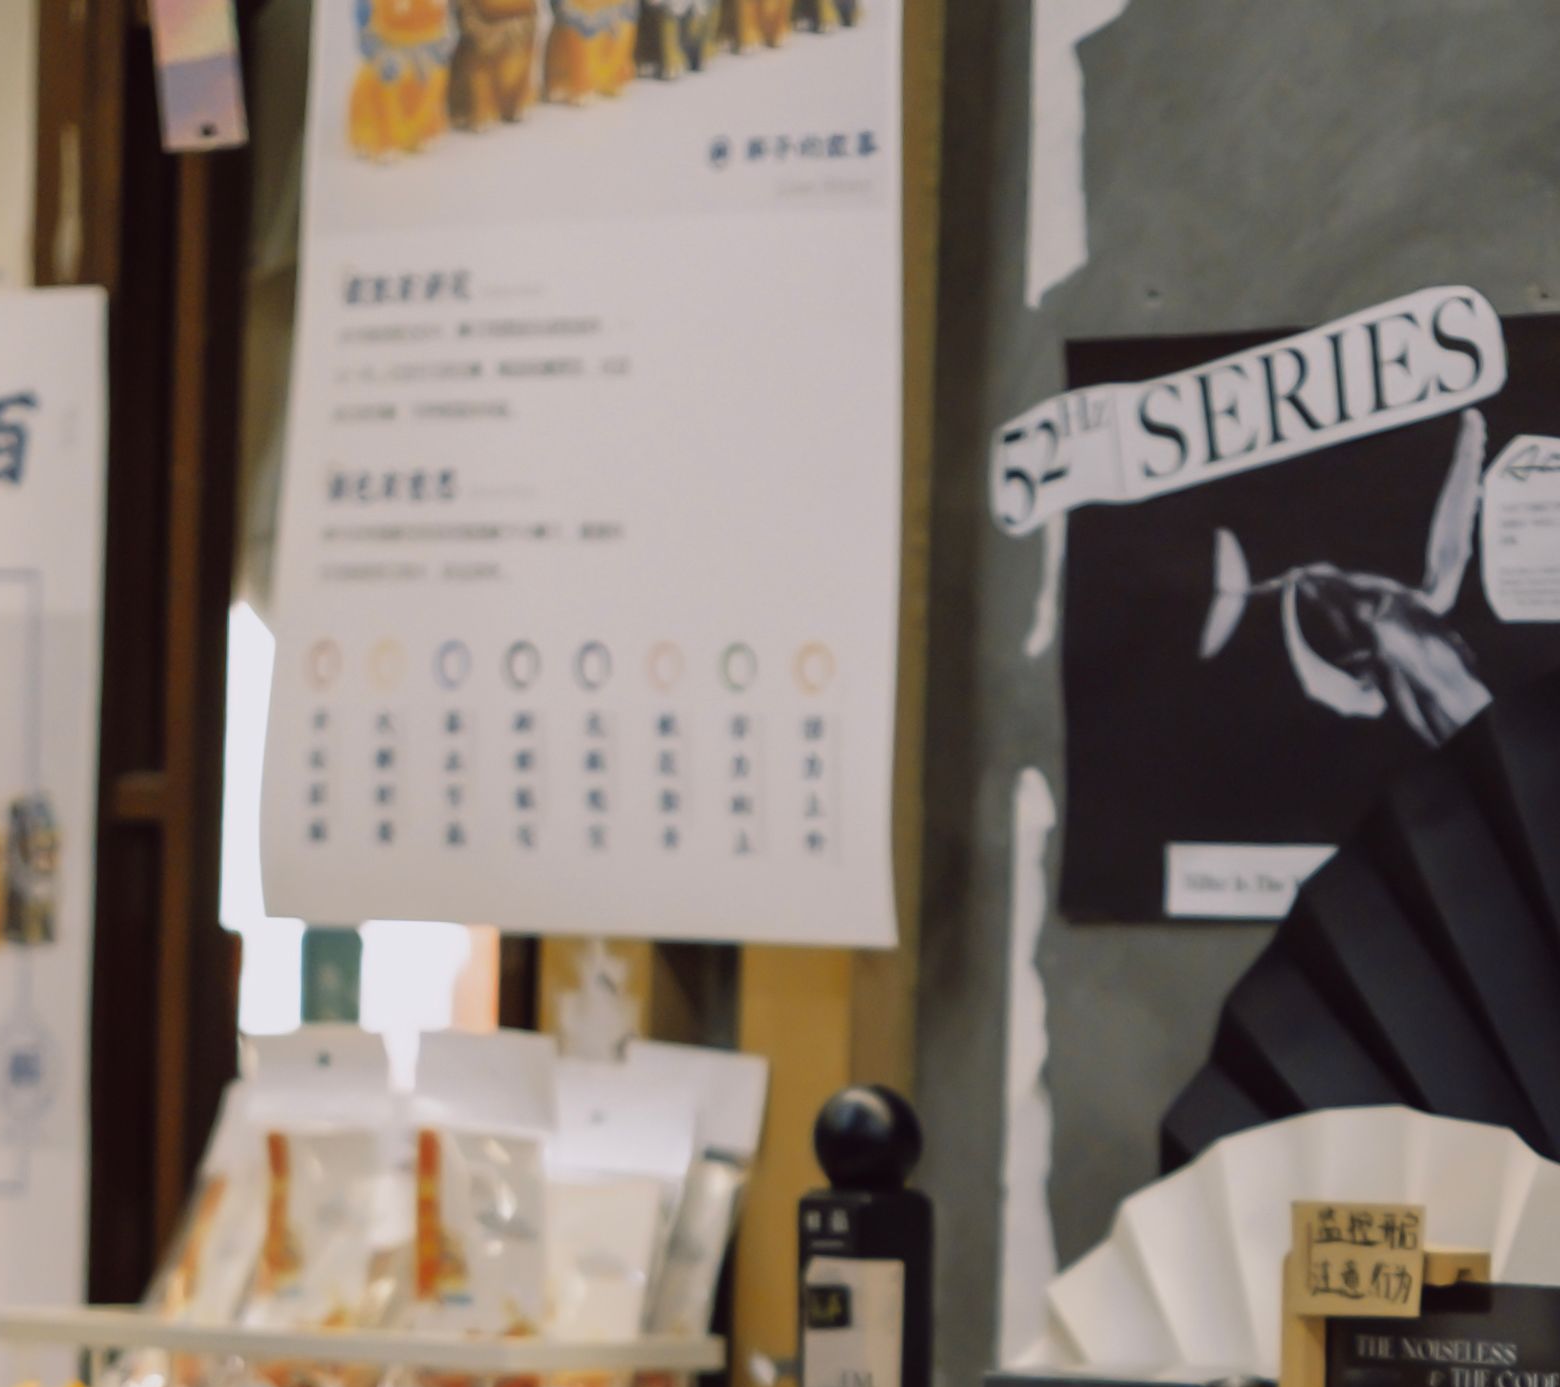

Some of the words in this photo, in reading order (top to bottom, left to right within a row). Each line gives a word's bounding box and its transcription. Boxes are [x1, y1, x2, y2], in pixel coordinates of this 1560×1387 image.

[1139, 296, 1484, 480] SERIES
[1355, 1335, 1394, 1359] THE
[1402, 1337, 1517, 1366] NOISELESS
